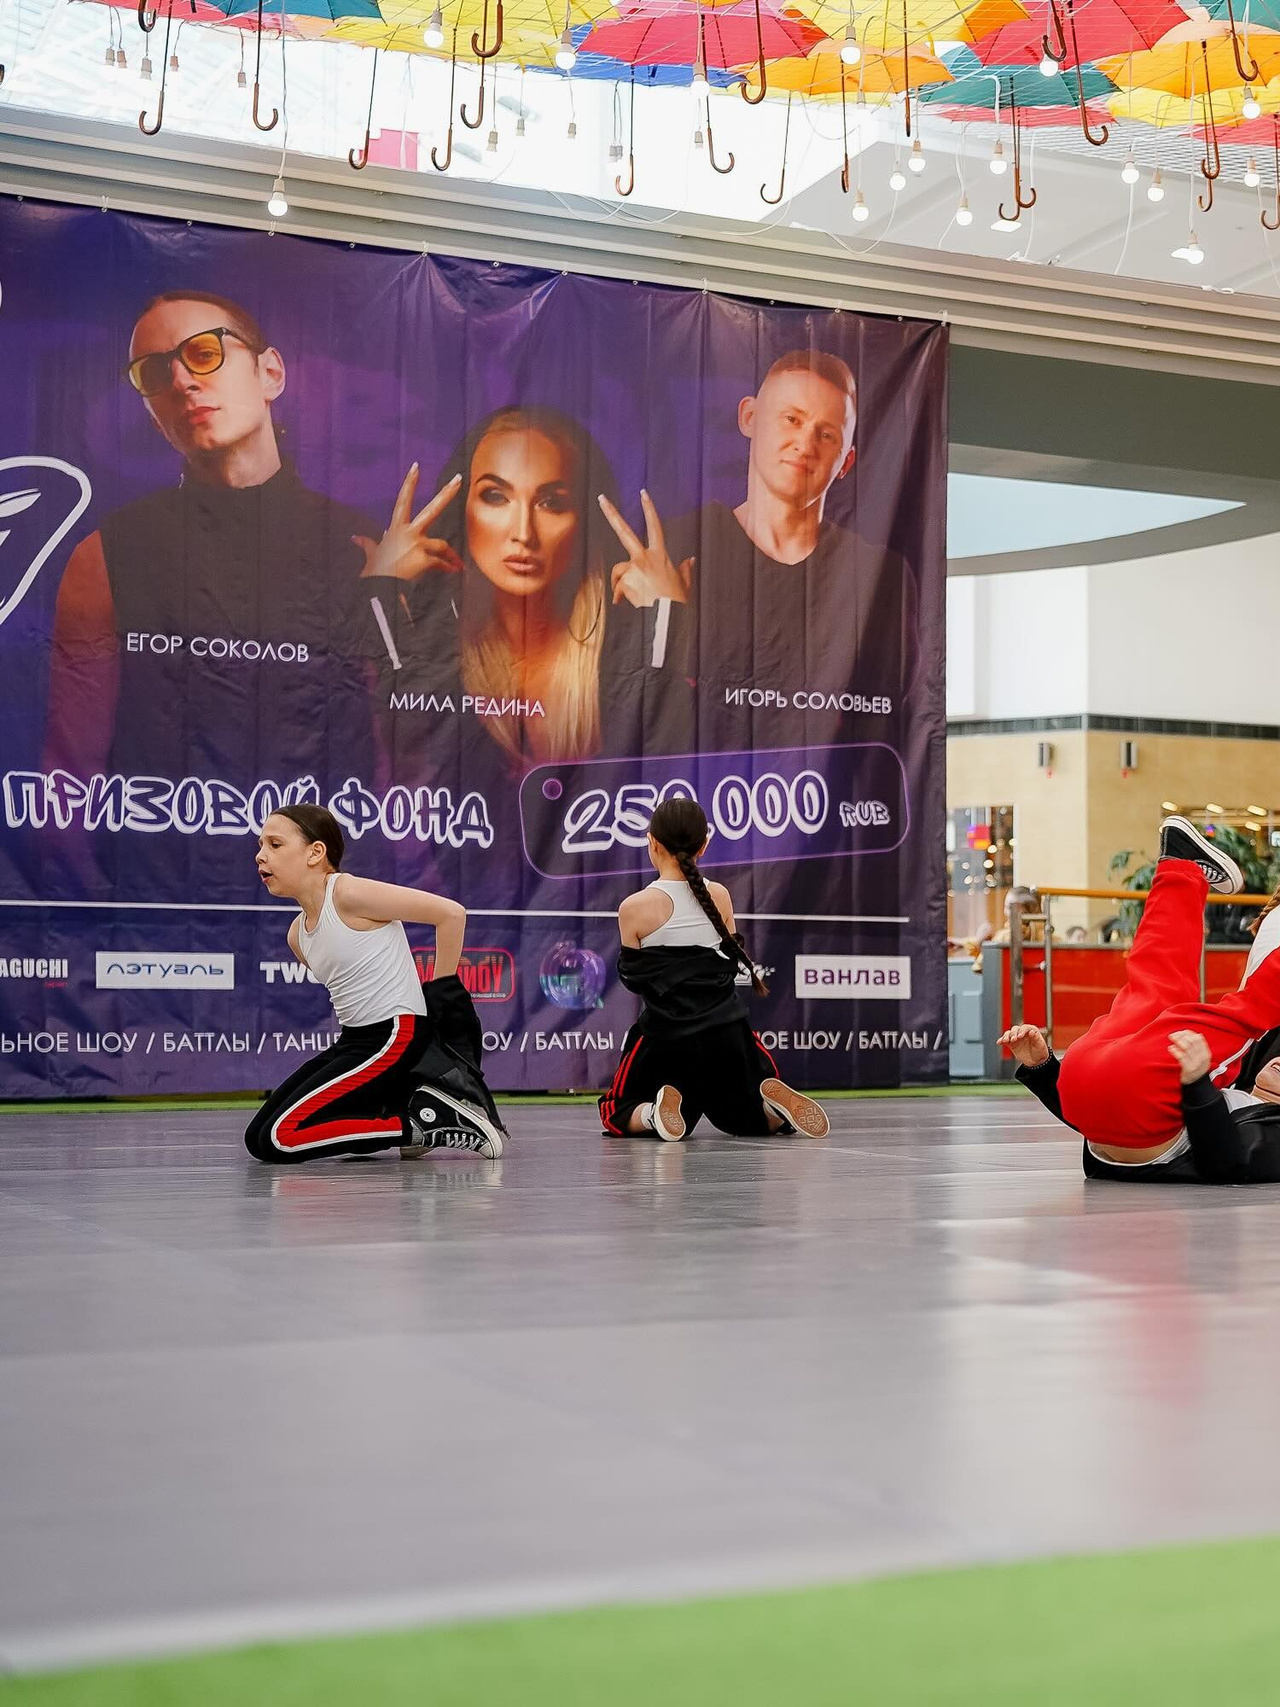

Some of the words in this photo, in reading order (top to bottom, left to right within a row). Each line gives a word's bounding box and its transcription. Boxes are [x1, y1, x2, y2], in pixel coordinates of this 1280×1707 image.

[126, 632, 184, 654] ЕГОР
[189, 635, 310, 663] СОКОЛОВ
[389, 691, 456, 714] МИЛА
[461, 695, 546, 718] РЕДИНА
[724, 686, 789, 709] ИГОРЬ
[792, 690, 893, 715] СОЛОВЬЕВ
[333, 776, 495, 849] ФОНД
[839, 800, 892, 827] RUB
[804, 968, 901, 986] ванлав
[1, 1032, 69, 1053] ЬНОЕ
[76, 1032, 138, 1053] ШОУ
[163, 1032, 250, 1053] БАТТЛЫ
[535, 1031, 614, 1050] БАТТЛЫ
[793, 1030, 841, 1050] ШОУ
[858, 1030, 928, 1050] БАТТЛЫ
